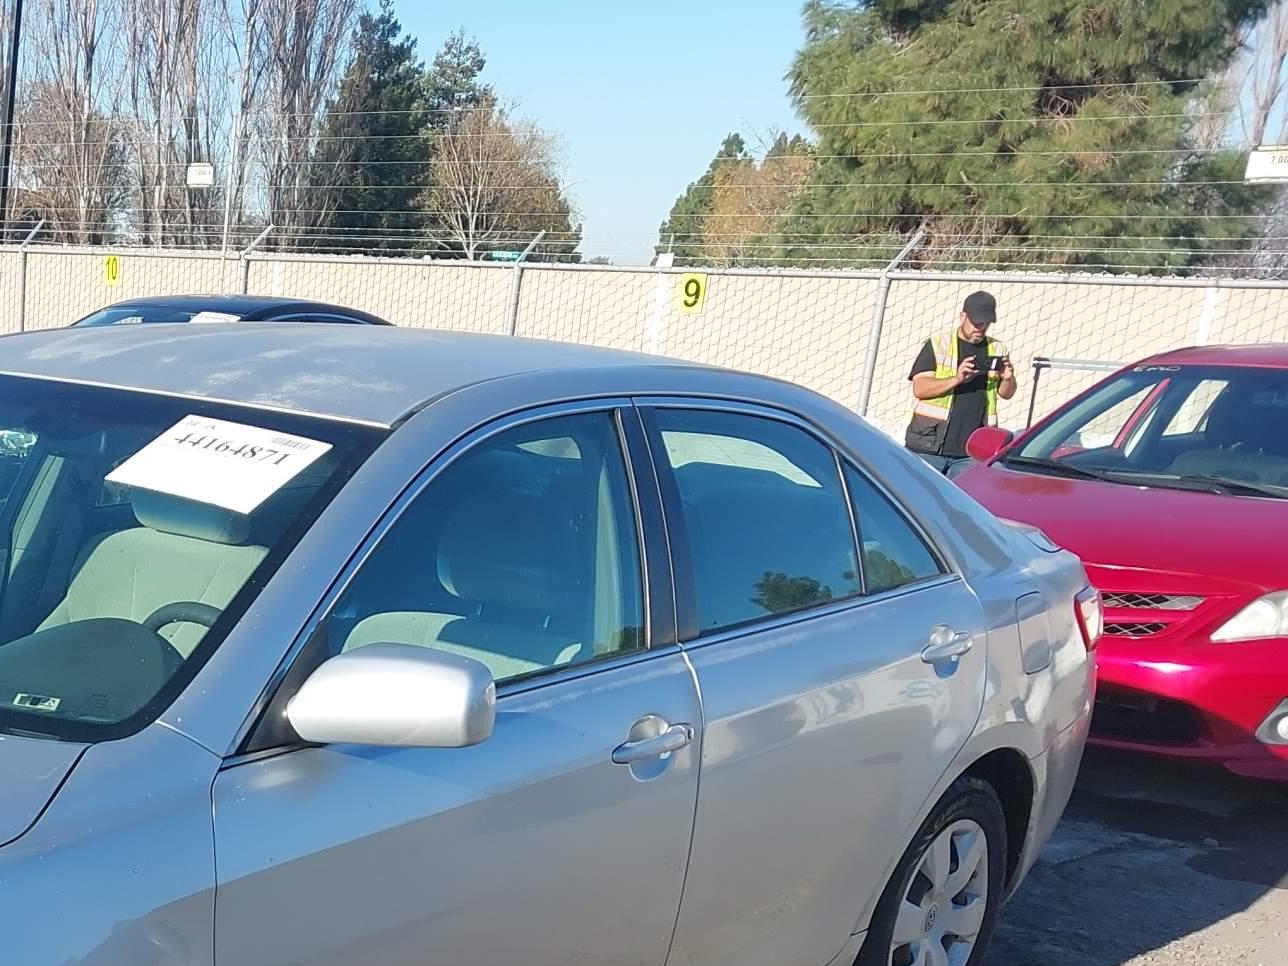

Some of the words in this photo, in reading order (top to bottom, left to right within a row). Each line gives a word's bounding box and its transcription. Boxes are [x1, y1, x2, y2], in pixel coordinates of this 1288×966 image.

[105, 256, 118, 281] 10
[683, 278, 701, 308] 9
[174, 432, 292, 466] 44164871
